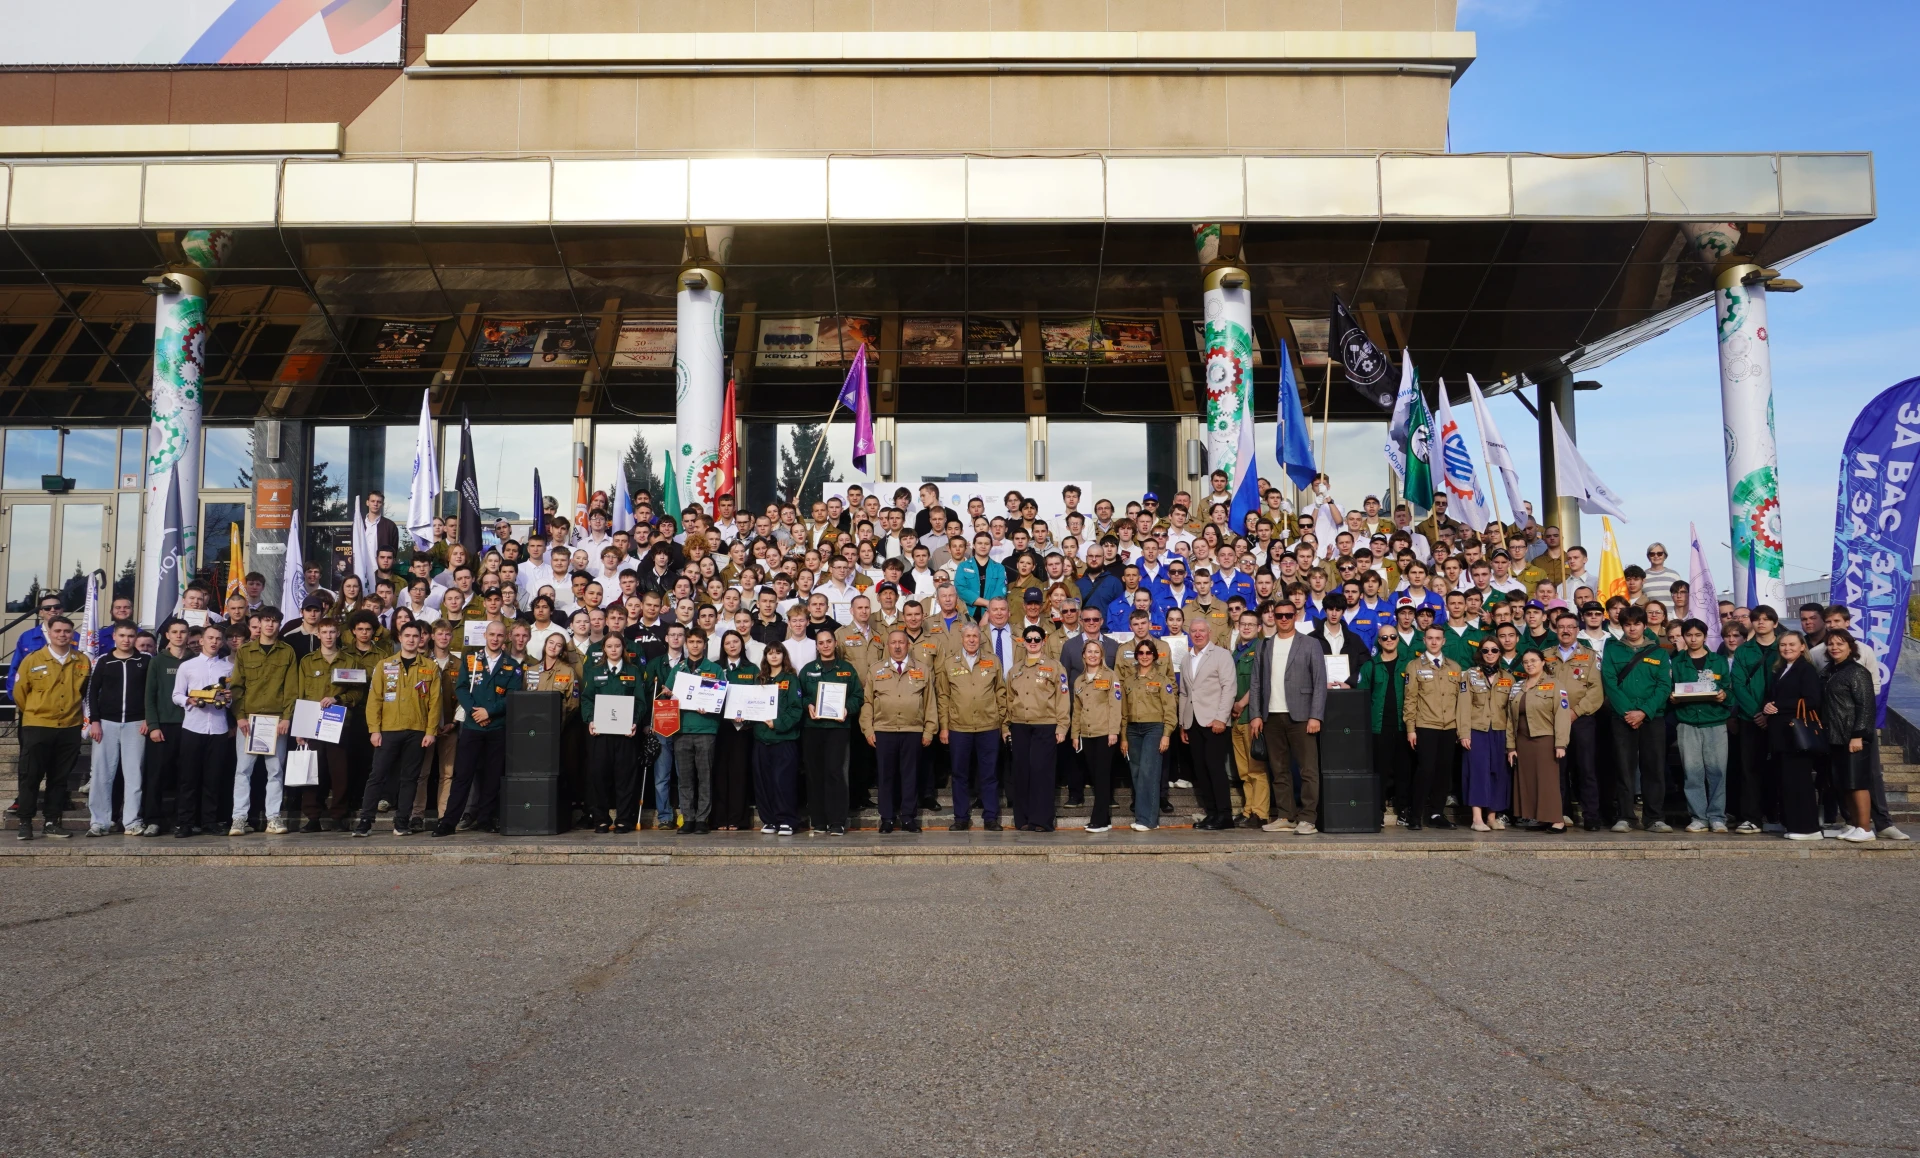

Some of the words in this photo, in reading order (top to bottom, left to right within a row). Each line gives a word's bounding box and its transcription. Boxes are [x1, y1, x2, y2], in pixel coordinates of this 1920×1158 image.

[1891, 402, 1920, 450] ЗА
[1854, 452, 1880, 480] И
[1848, 490, 1873, 540] ЗА
[1870, 460, 1915, 541] ВАС,
[1844, 552, 1864, 640] КАМ
[1868, 553, 1895, 599] ЗА
[634, 635, 657, 643] FILA
